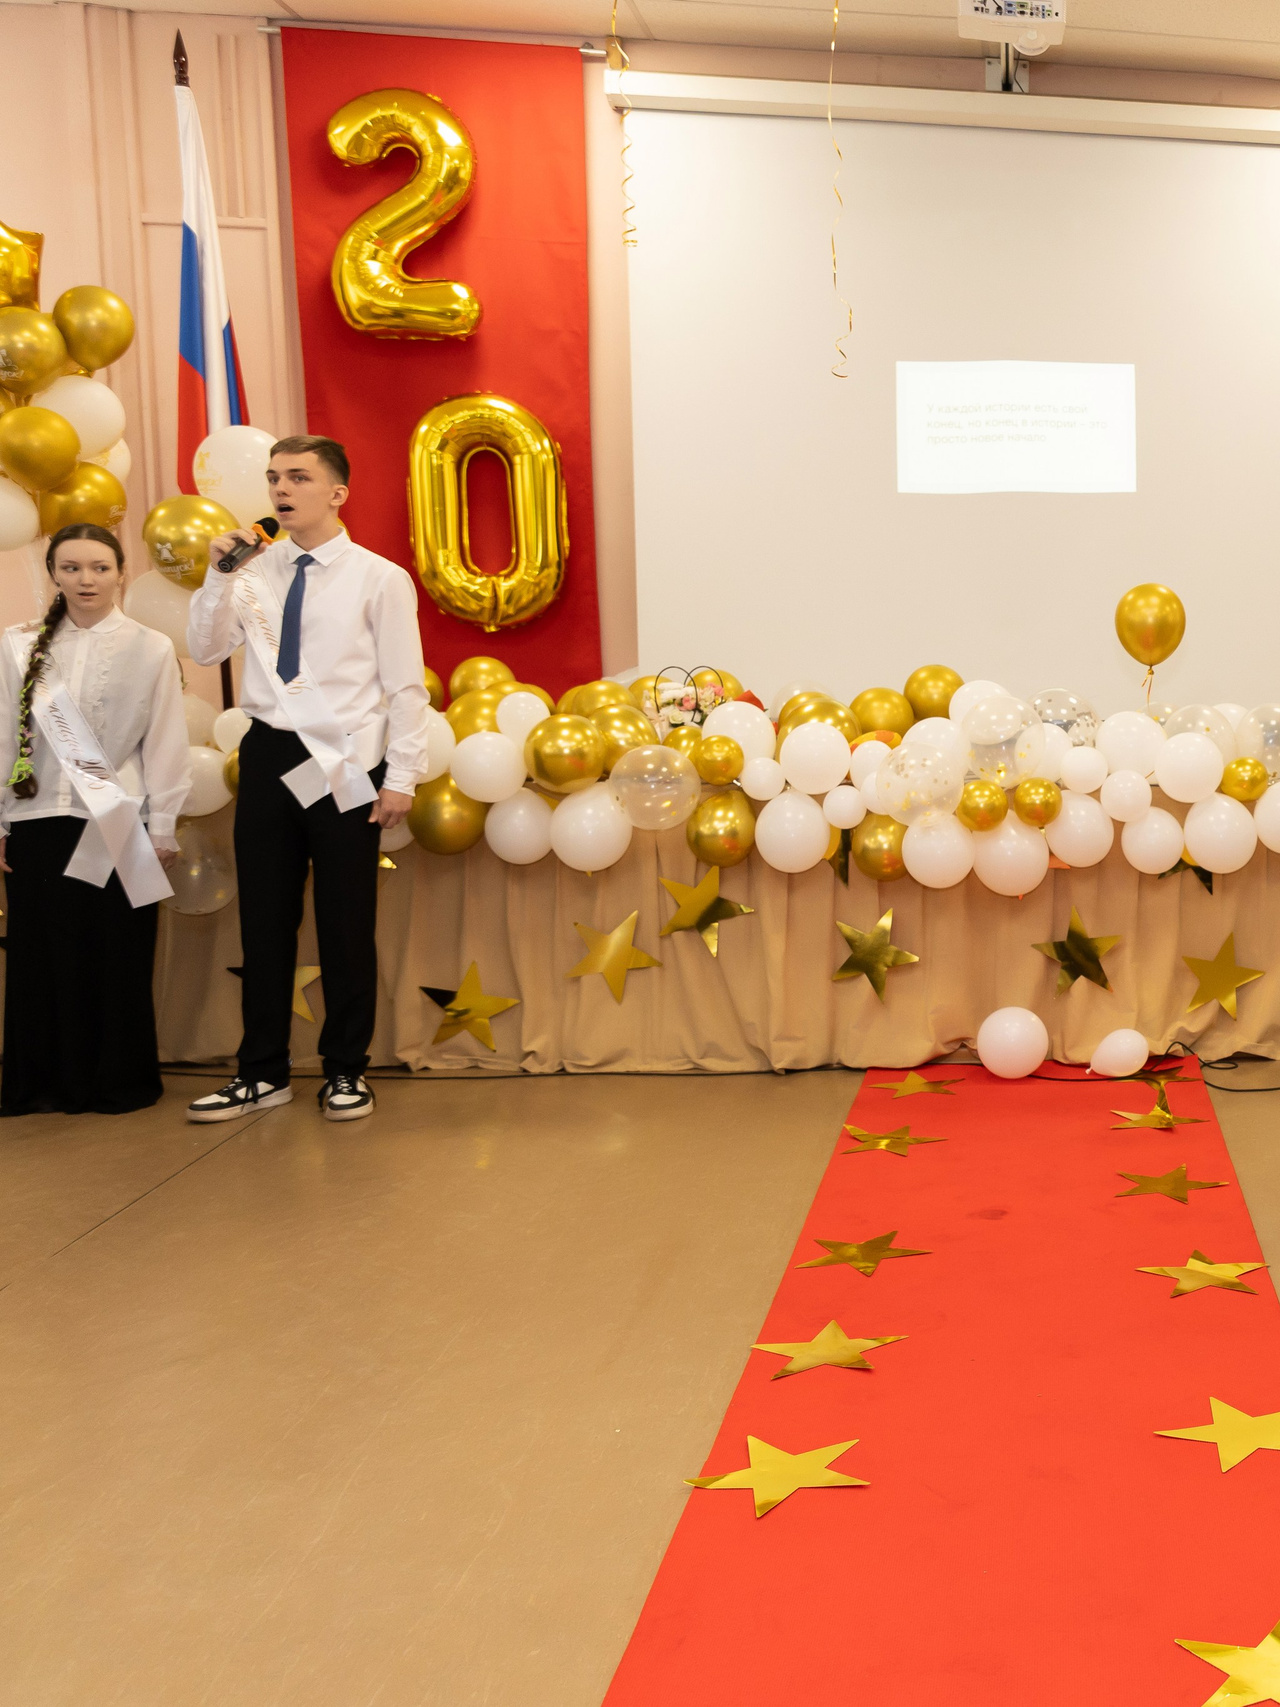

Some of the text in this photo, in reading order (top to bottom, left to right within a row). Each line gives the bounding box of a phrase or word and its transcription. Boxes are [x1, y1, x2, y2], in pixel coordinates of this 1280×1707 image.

[327, 87, 482, 341] 2
[926, 402, 1088, 415] У каждой истории есть свой
[967, 420, 982, 429] но
[985, 419, 1019, 429] конец
[1031, 419, 1077, 430] истории
[1088, 421, 1108, 430] это
[927, 434, 968, 445] просто
[970, 433, 1004, 443] новое
[407, 390, 570, 633] 0
